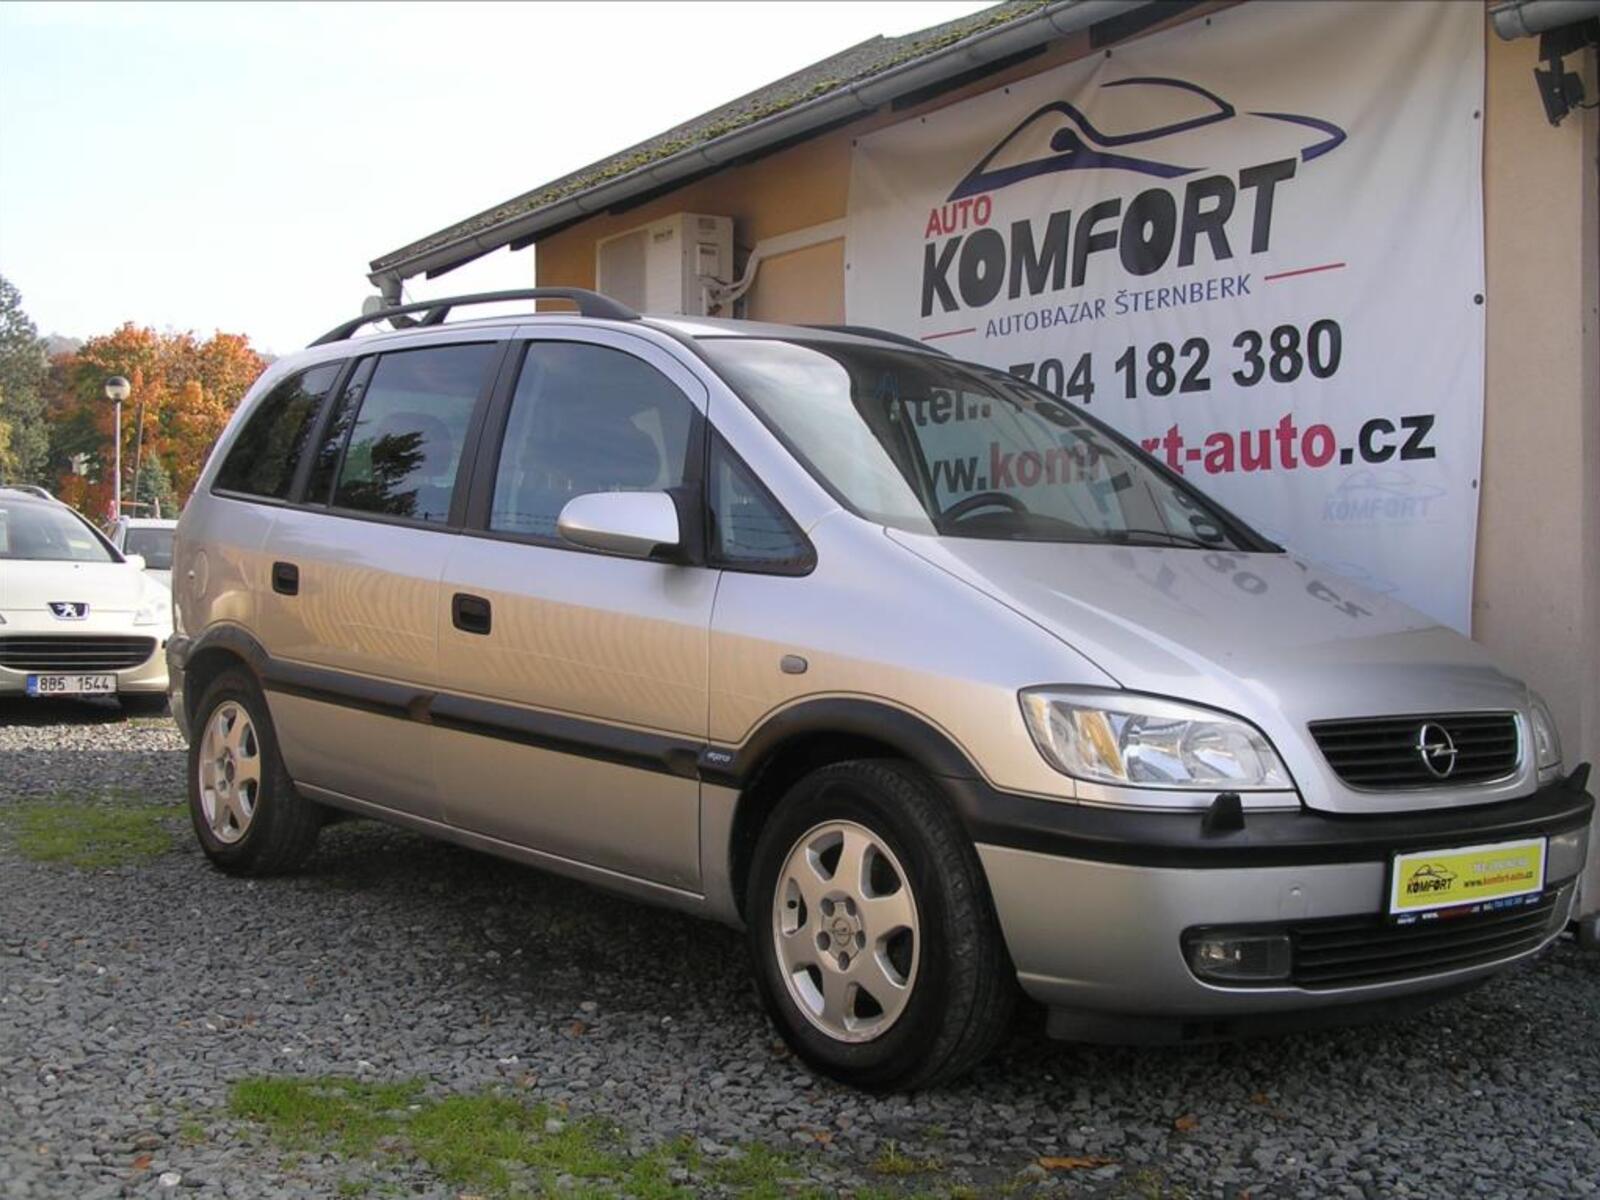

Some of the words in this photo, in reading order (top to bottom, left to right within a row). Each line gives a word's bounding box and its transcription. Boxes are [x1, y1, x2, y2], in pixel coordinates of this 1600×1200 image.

[920, 157, 1297, 318] KOMFORT
[925, 194, 993, 239] AUTO
[985, 297, 1107, 339] AUTOBAZAR
[1114, 273, 1252, 316] ŠTERNBERK
[1114, 337, 1212, 399] 182
[1231, 318, 1343, 387] 380
[77, 677, 110, 692] 1544
[1406, 878, 1453, 894] KOMFORT
